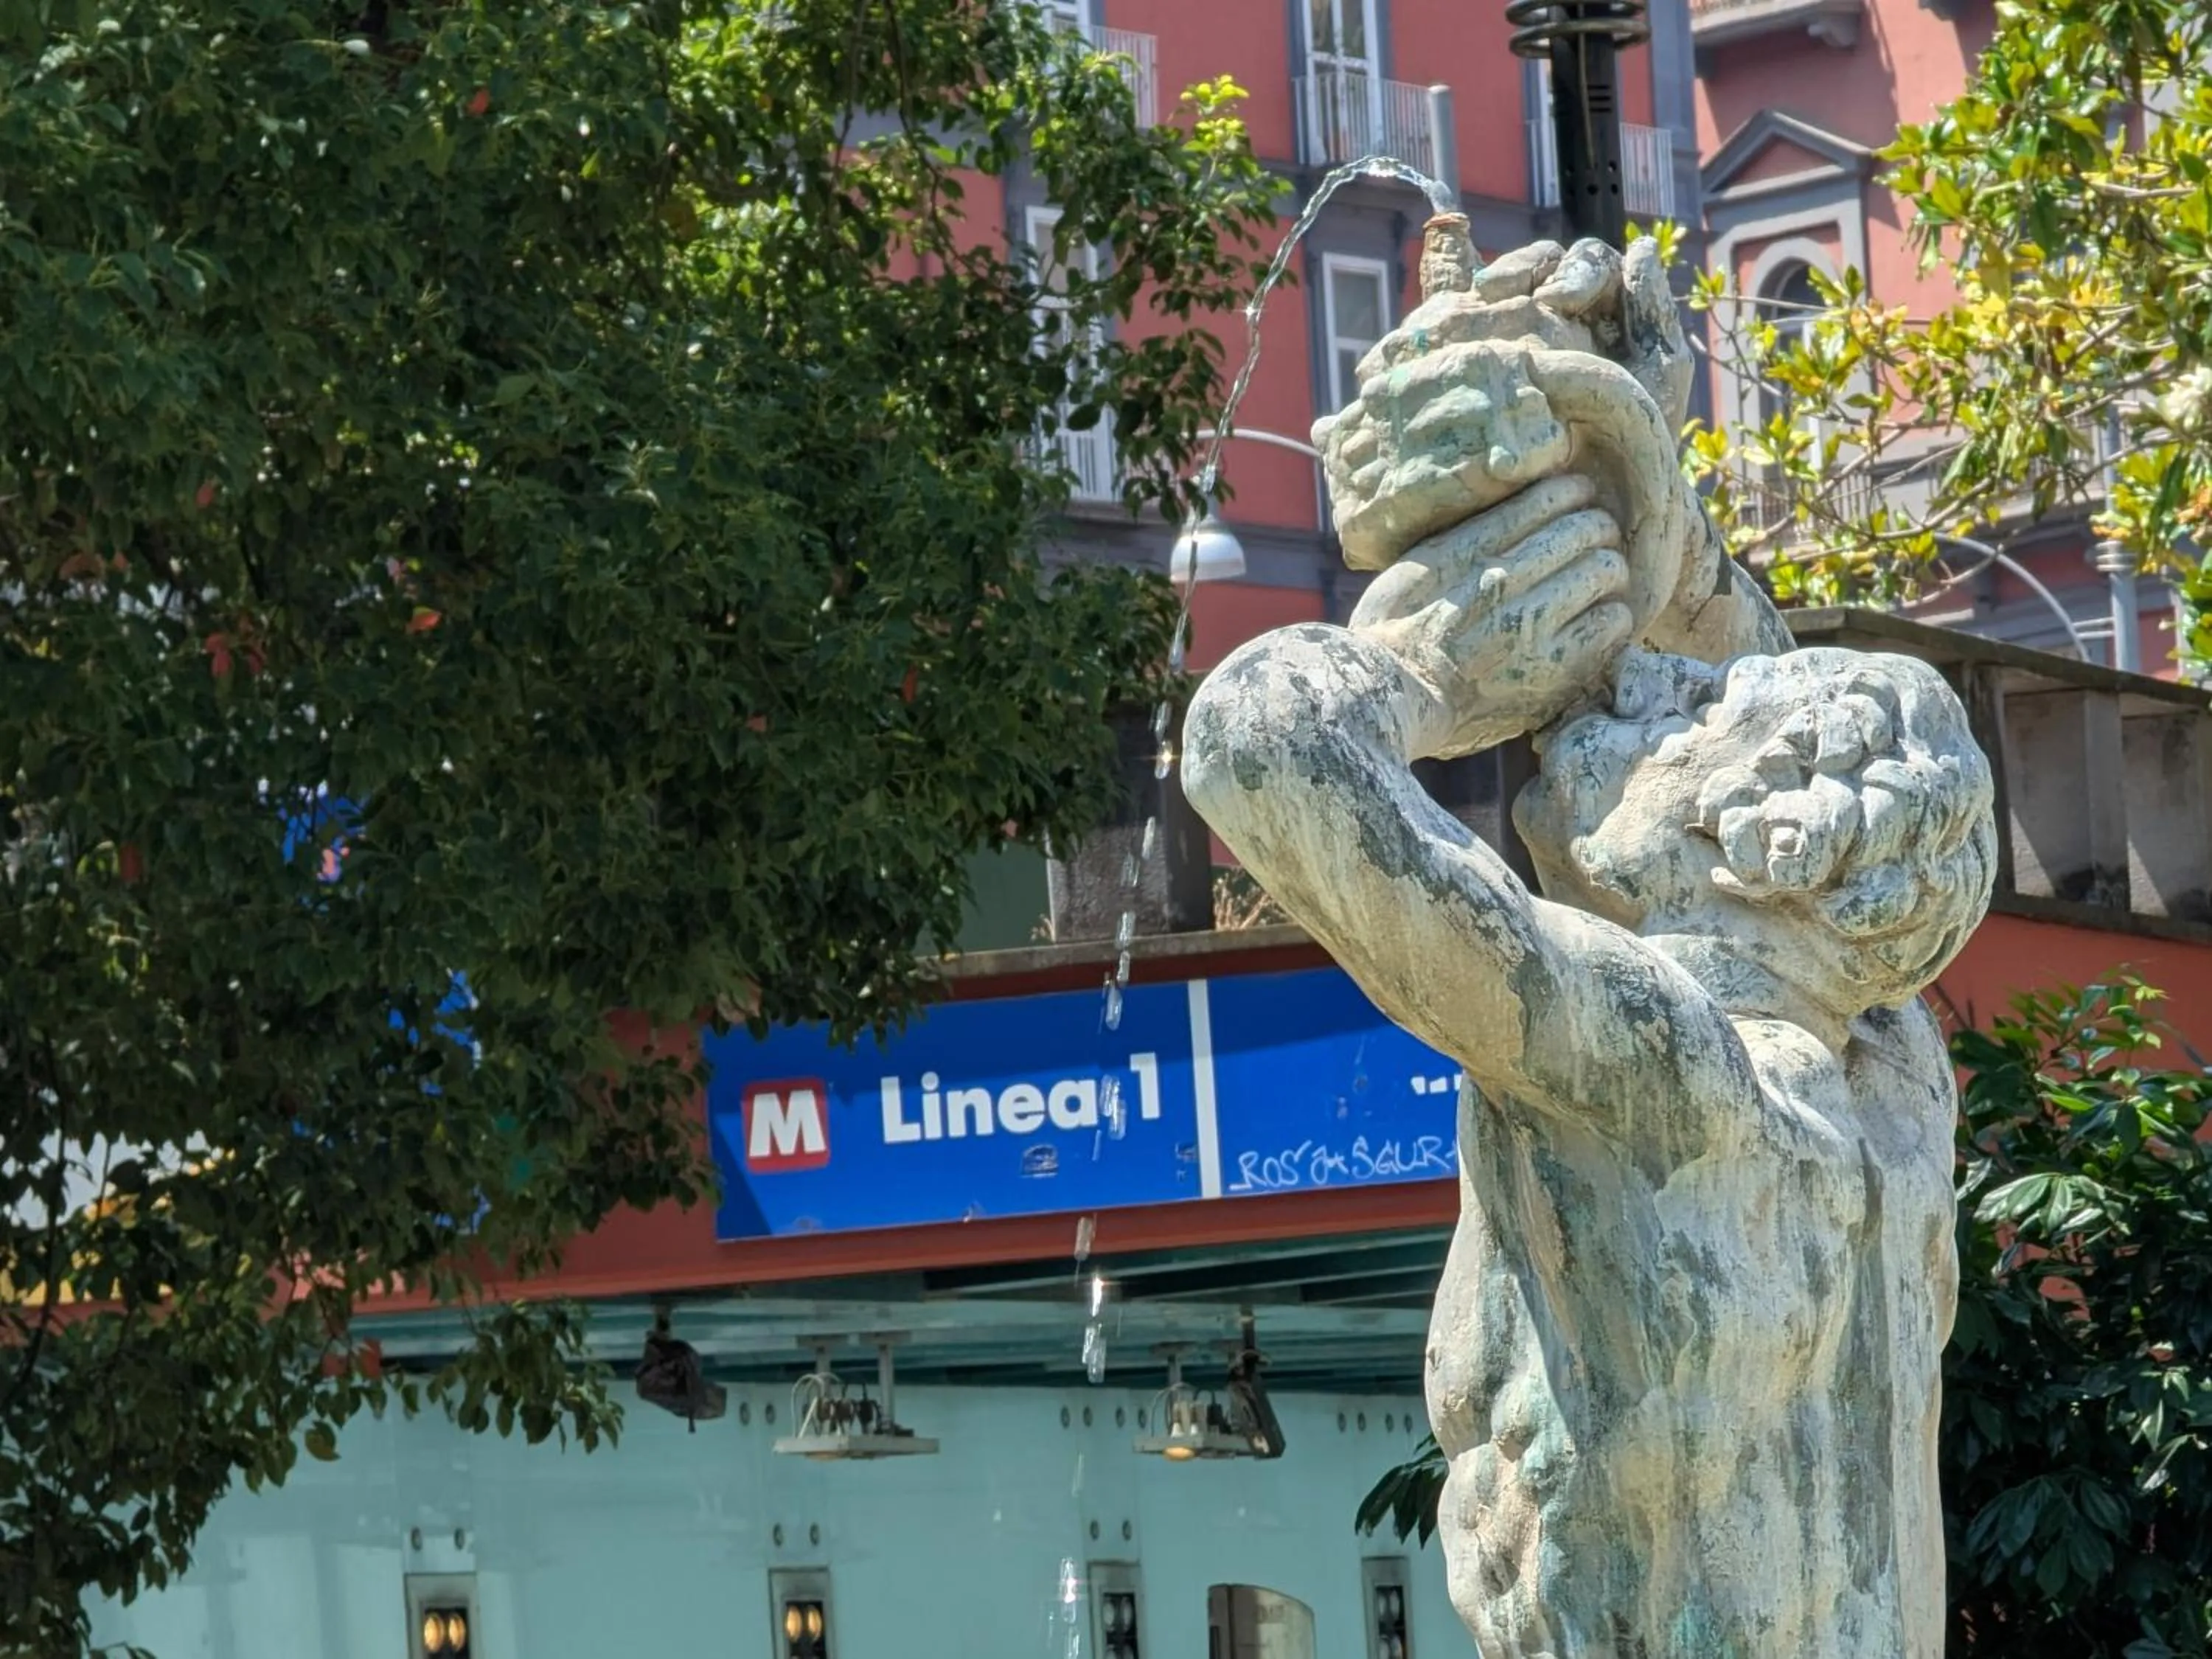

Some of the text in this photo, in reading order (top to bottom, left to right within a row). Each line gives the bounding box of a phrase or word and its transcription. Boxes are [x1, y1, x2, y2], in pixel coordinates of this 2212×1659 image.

[748, 1088, 827, 1158] M
[880, 1051, 1160, 1144] Linea 1
